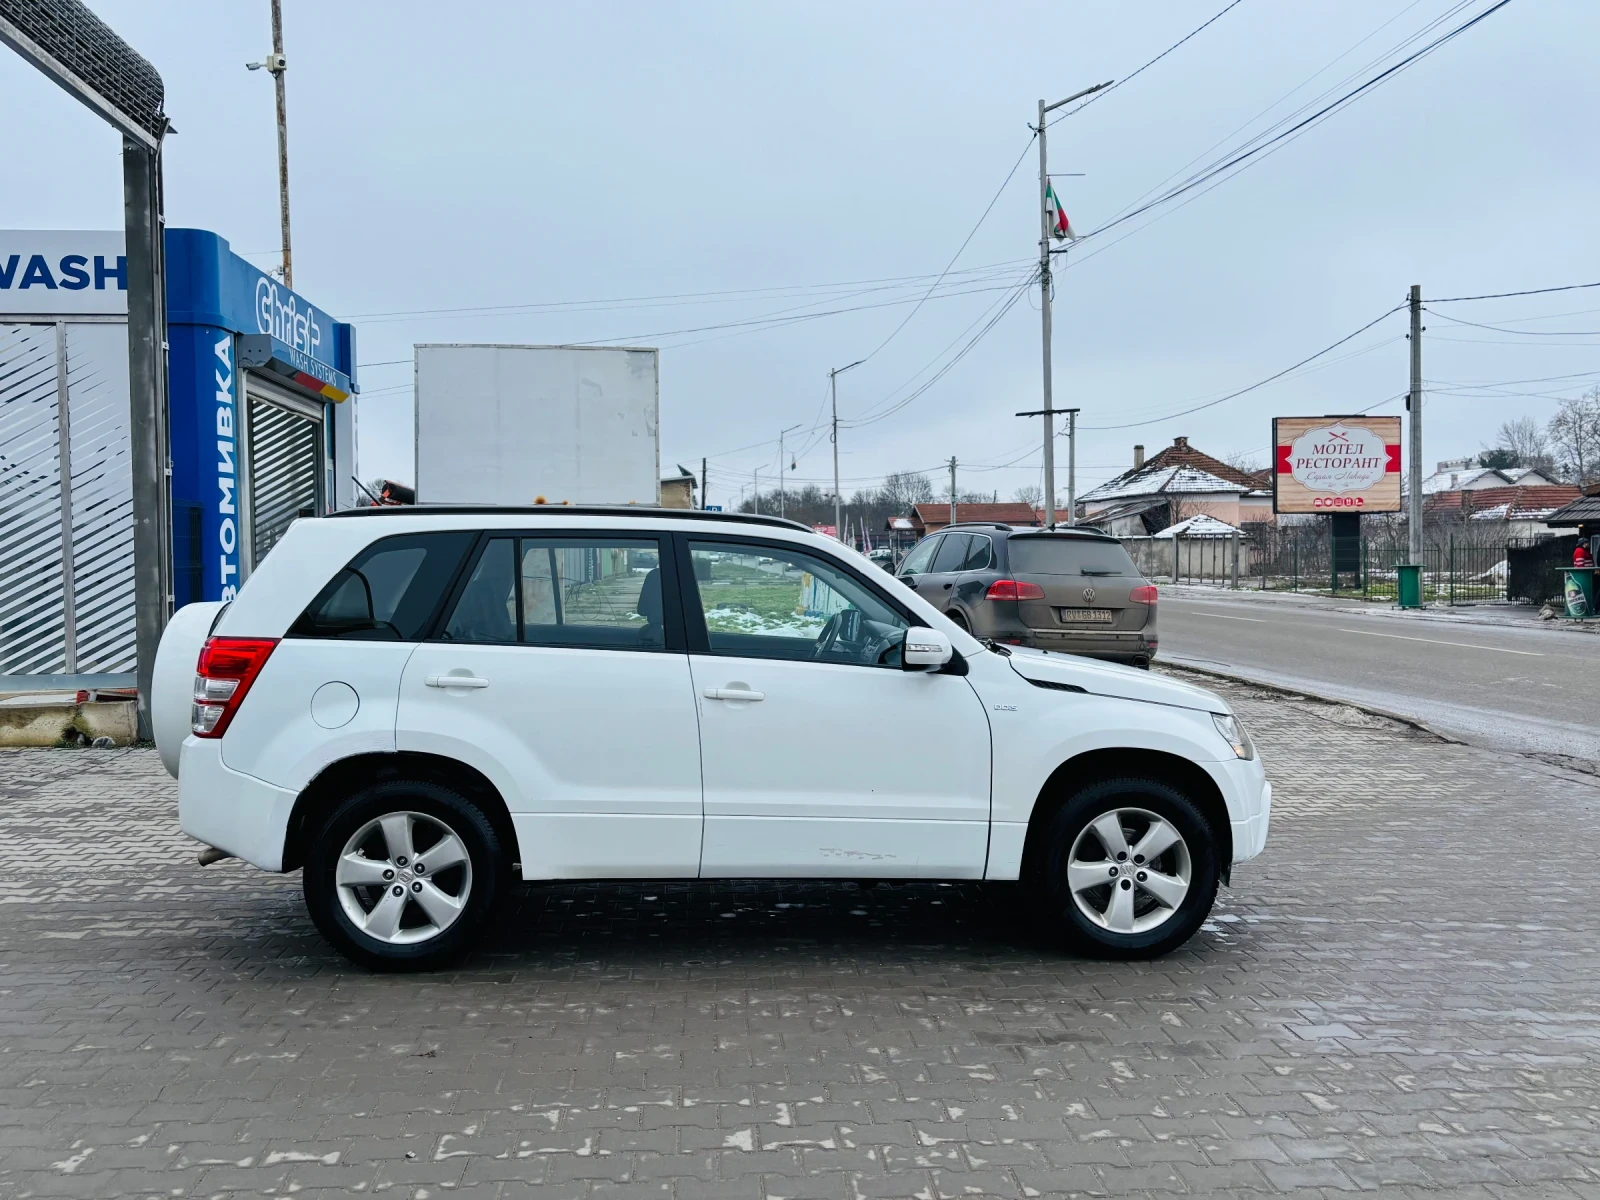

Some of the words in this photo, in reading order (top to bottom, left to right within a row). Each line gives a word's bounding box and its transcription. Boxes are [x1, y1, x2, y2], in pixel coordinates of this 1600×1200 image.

[289, 347, 309, 371] WASH
[311, 358, 337, 387] SYSTEMS
[1312, 443, 1364, 455] МОТЕЛ
[1296, 457, 1381, 469] РЕСТОРАНТ
